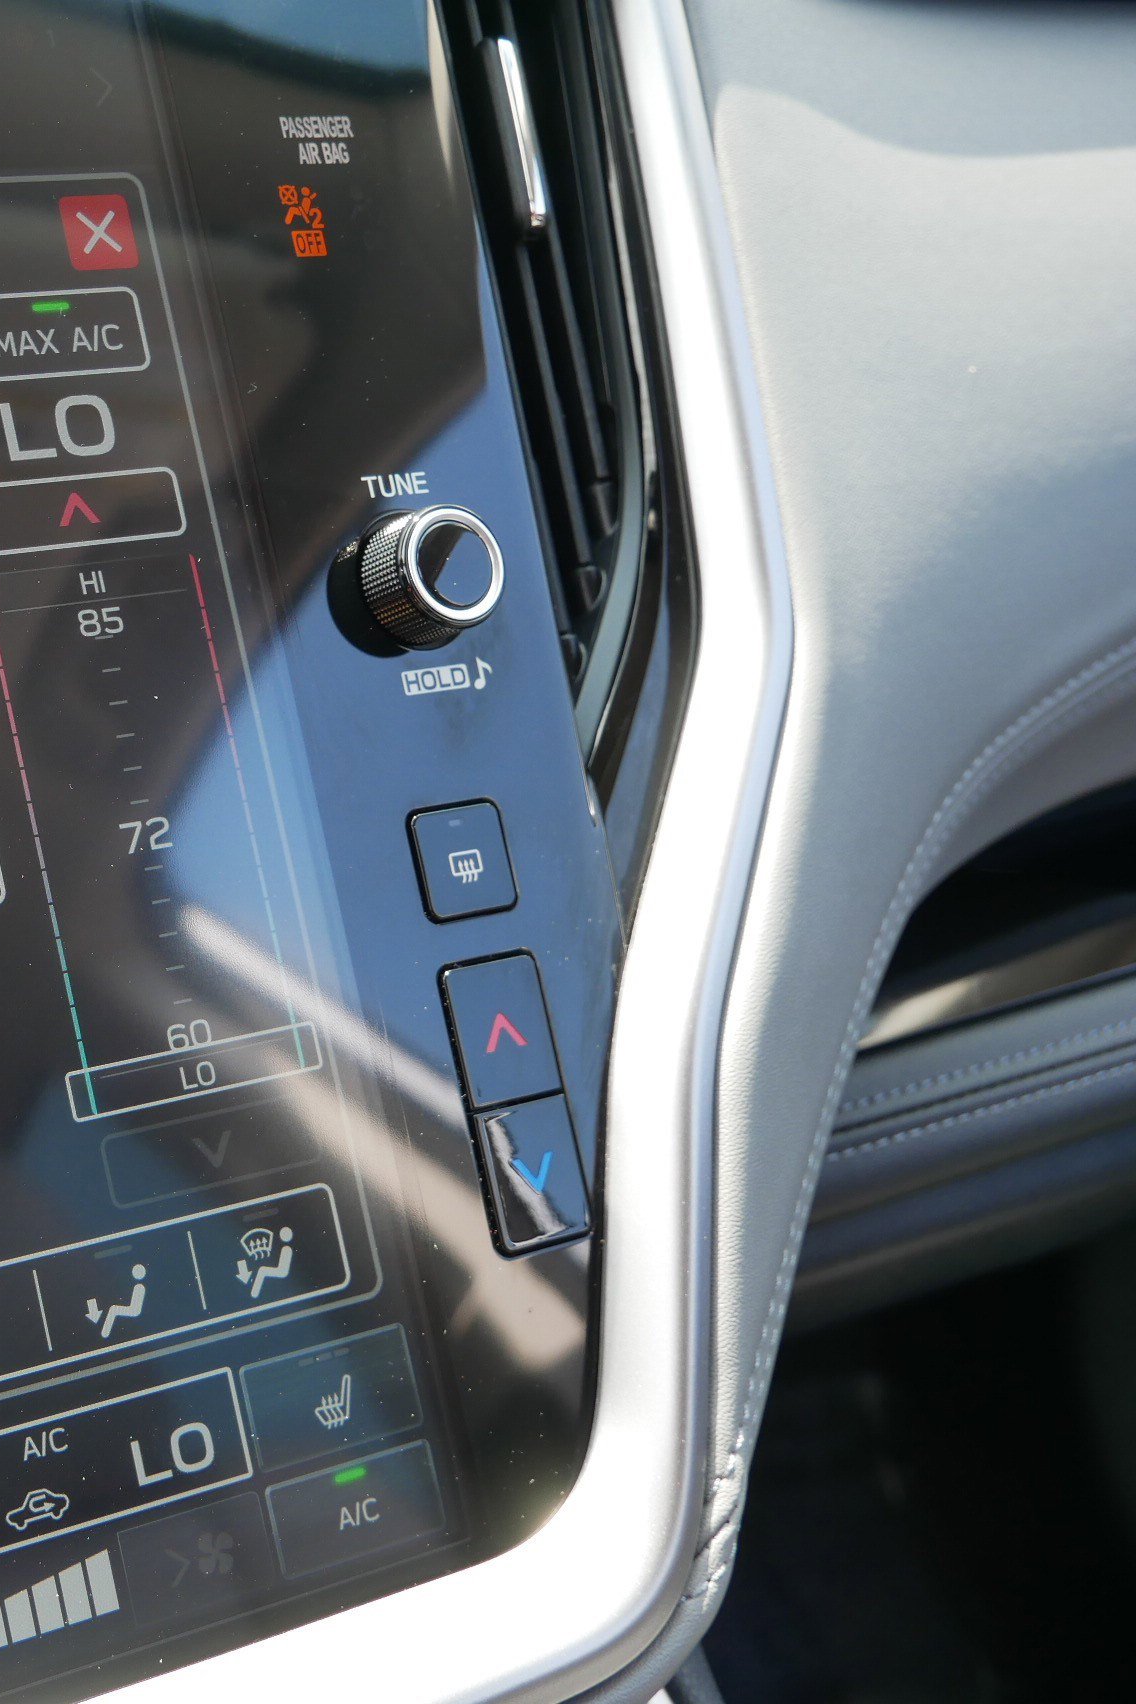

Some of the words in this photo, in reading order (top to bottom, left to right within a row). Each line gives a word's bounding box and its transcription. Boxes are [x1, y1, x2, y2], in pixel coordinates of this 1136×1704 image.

[279, 116, 354, 138] PASSENGER
[299, 143, 322, 165] AIR
[322, 142, 350, 164] BAG
[294, 232, 323, 254] OFF
[72, 324, 124, 352] A/C
[361, 471, 430, 498] TUNE
[78, 570, 107, 595] HI
[77, 606, 124, 637] 85
[402, 666, 467, 694] HOLD
[118, 817, 174, 854] 72
[167, 1019, 213, 1053] 60
[178, 1060, 217, 1090] LO
[22, 1427, 68, 1461] A/C
[131, 1421, 215, 1487] LO
[339, 1497, 381, 1531] A/C
